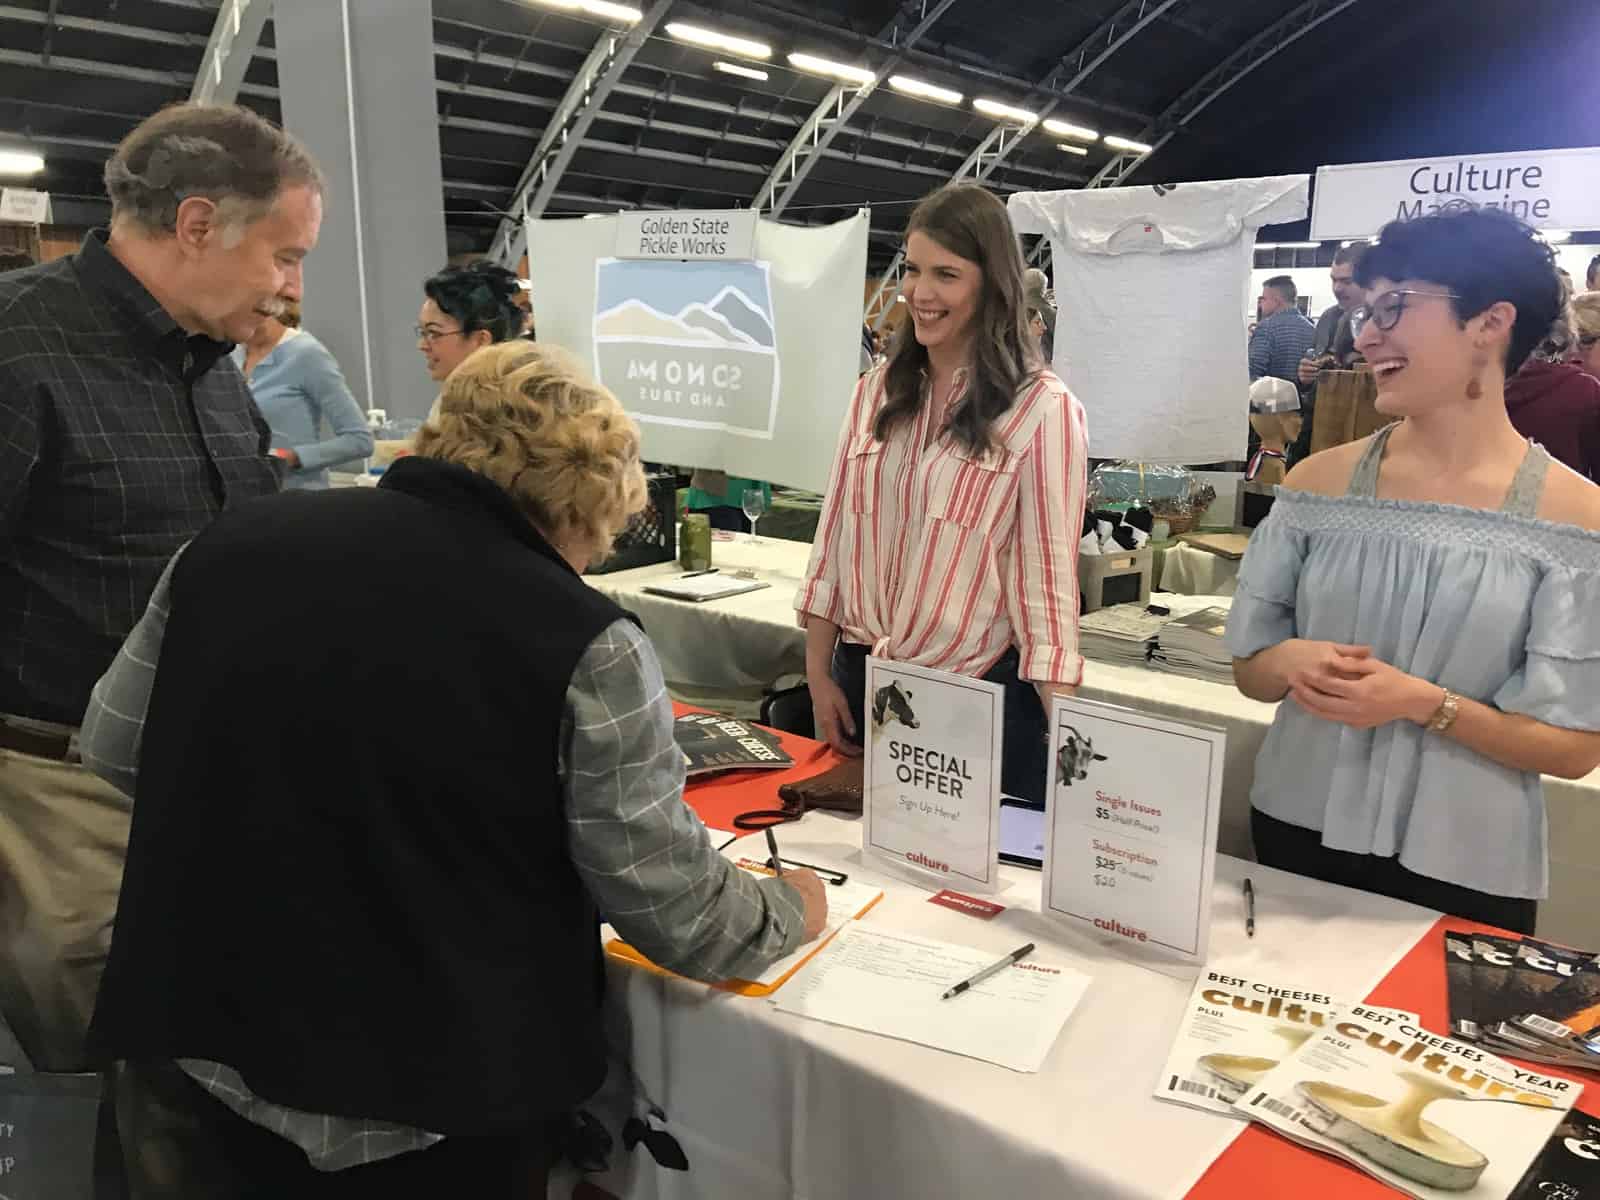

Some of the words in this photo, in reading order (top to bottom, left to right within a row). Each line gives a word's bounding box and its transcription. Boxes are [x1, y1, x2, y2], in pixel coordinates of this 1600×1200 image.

[1409, 161, 1542, 194] Culture
[1396, 193, 1551, 219] Maine
[641, 217, 688, 234] Golden
[691, 217, 729, 234] State
[640, 236, 678, 254] Pickle
[681, 237, 726, 255] Works
[889, 740, 972, 780] SPECIAL
[896, 764, 963, 799] OFFER
[899, 794, 917, 811] Sign
[920, 801, 932, 814] Up
[934, 806, 960, 821] Here!
[1095, 790, 1127, 810] Single
[1130, 799, 1162, 816] Issues
[1095, 807, 1110, 820] $5
[905, 851, 949, 873] culture
[1092, 839, 1158, 865] Subscription
[1093, 917, 1147, 942] culture
[1207, 971, 1248, 988] BEST
[1252, 983, 1331, 1006] CHEESES
[1197, 1006, 1225, 1019] PLUS
[1201, 989, 1325, 1028] cult
[1323, 1035, 1352, 1050] PLUS
[1351, 1007, 1396, 1026] BEST
[1399, 1025, 1485, 1063] CHEESES
[1513, 1068, 1570, 1092] YEAR
[1335, 1022, 1554, 1110] culture
